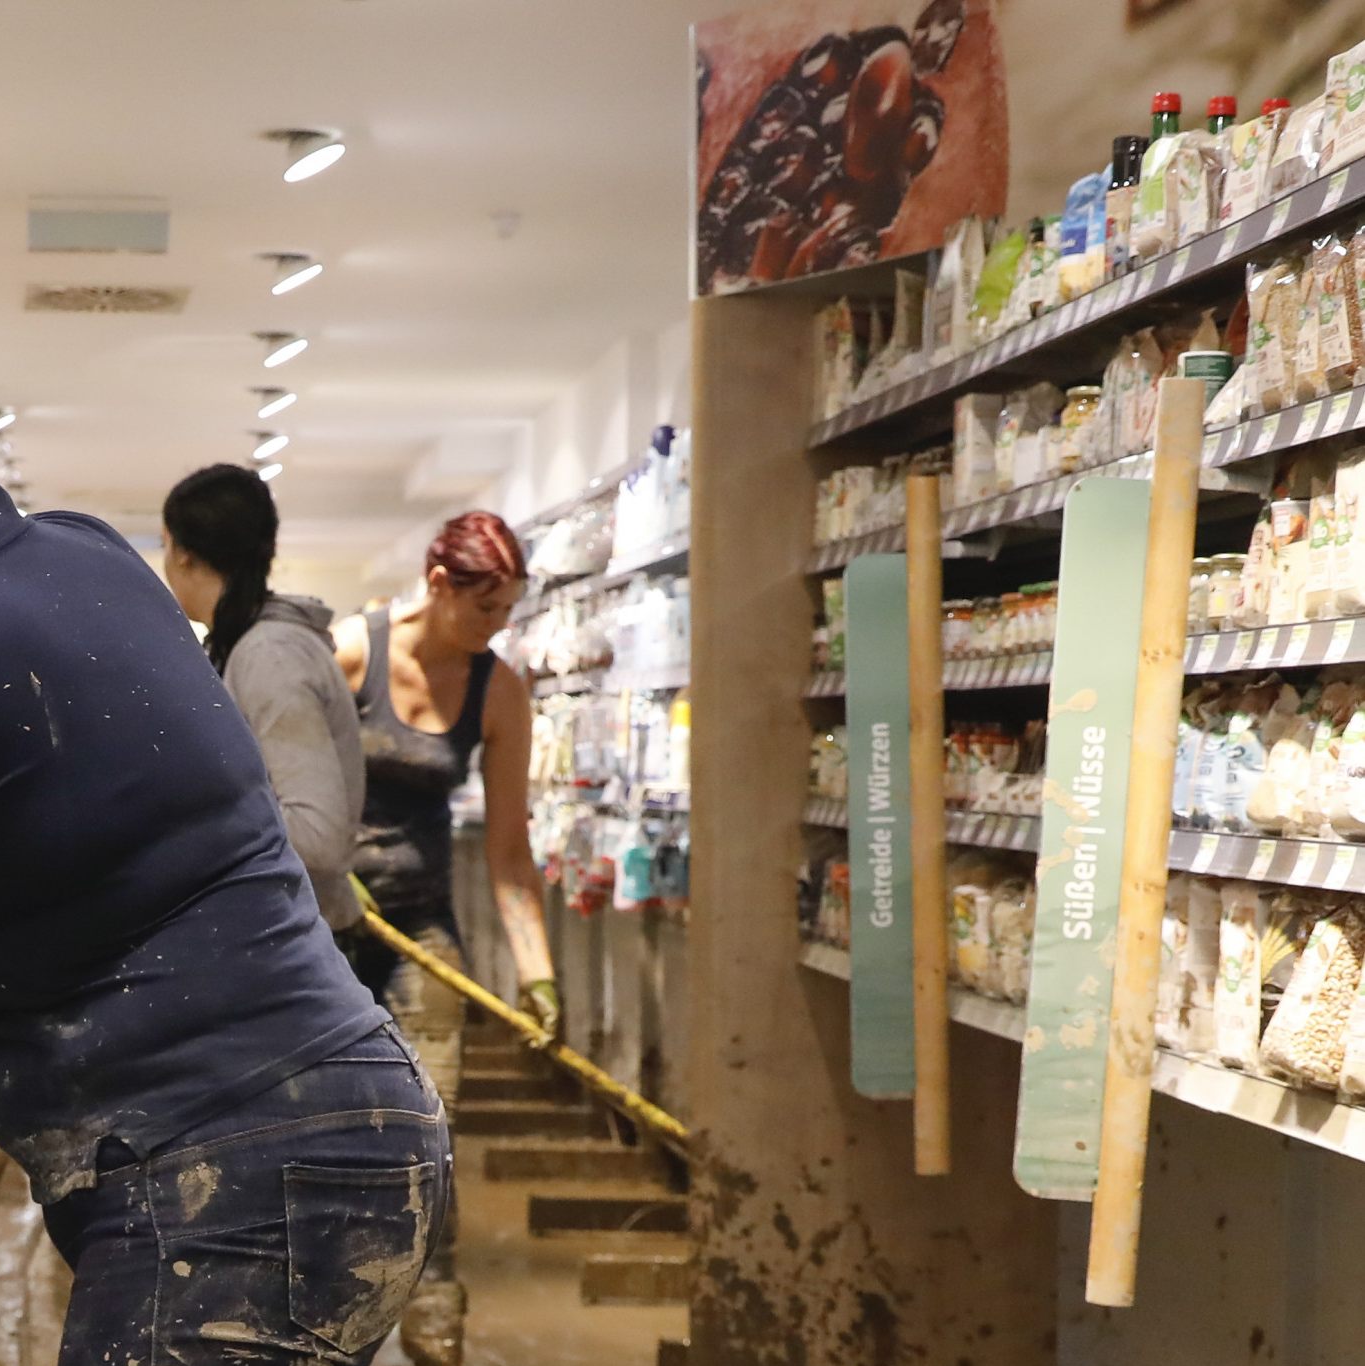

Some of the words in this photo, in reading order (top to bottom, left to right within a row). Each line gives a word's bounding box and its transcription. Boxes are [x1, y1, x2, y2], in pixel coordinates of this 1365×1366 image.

[867, 722, 891, 812] Würzen
[1072, 726, 1107, 818] Nüsse
[869, 828, 894, 928] Getreide
[1062, 843, 1098, 941] Süßen
